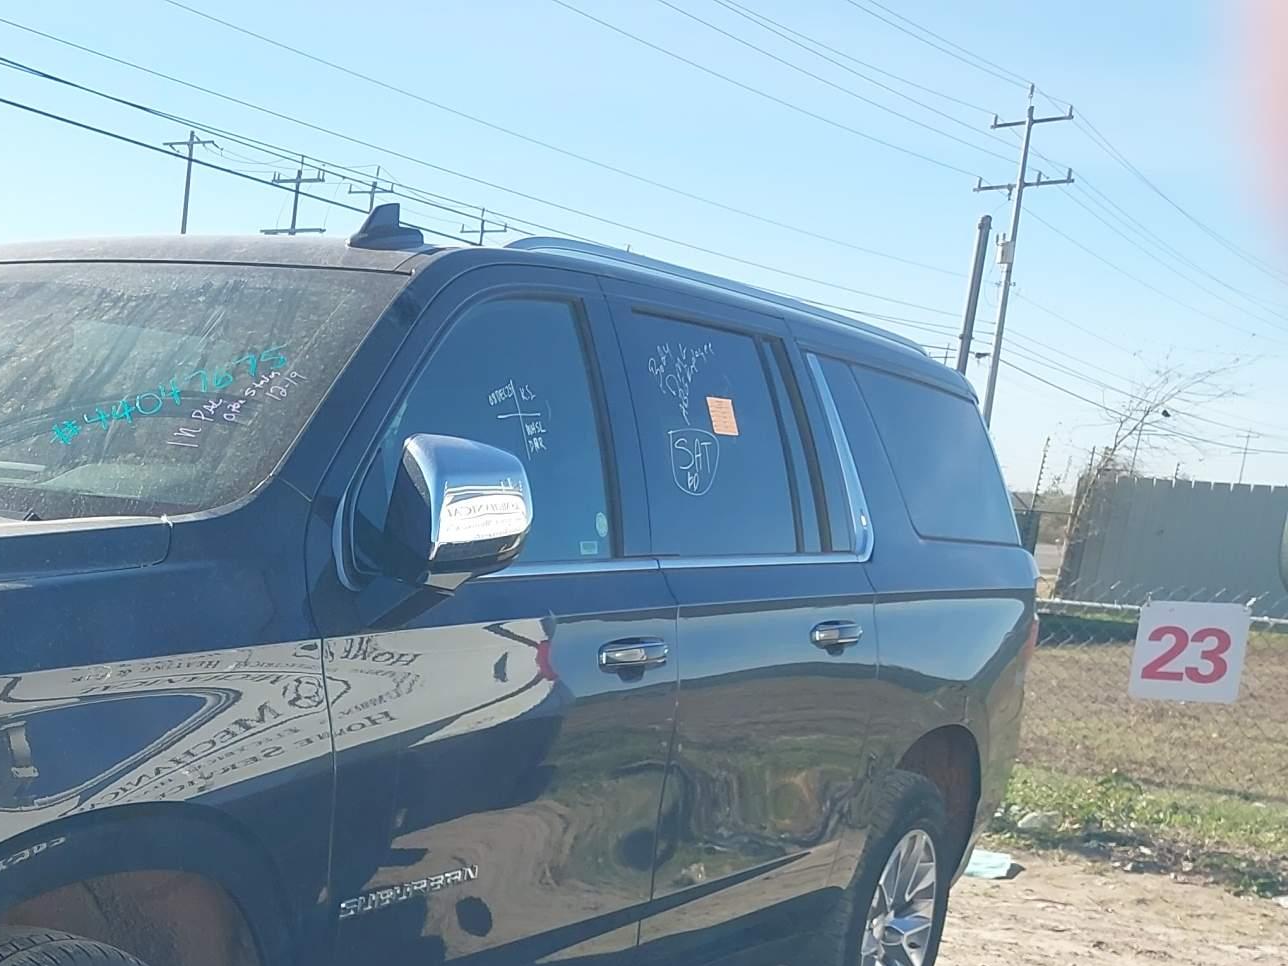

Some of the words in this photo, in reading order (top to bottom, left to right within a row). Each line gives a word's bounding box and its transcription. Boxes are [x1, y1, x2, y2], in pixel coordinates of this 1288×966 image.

[674, 438, 712, 473] SAT
[1141, 625, 1231, 684] 23
[338, 864, 479, 919] SUBURBAN
